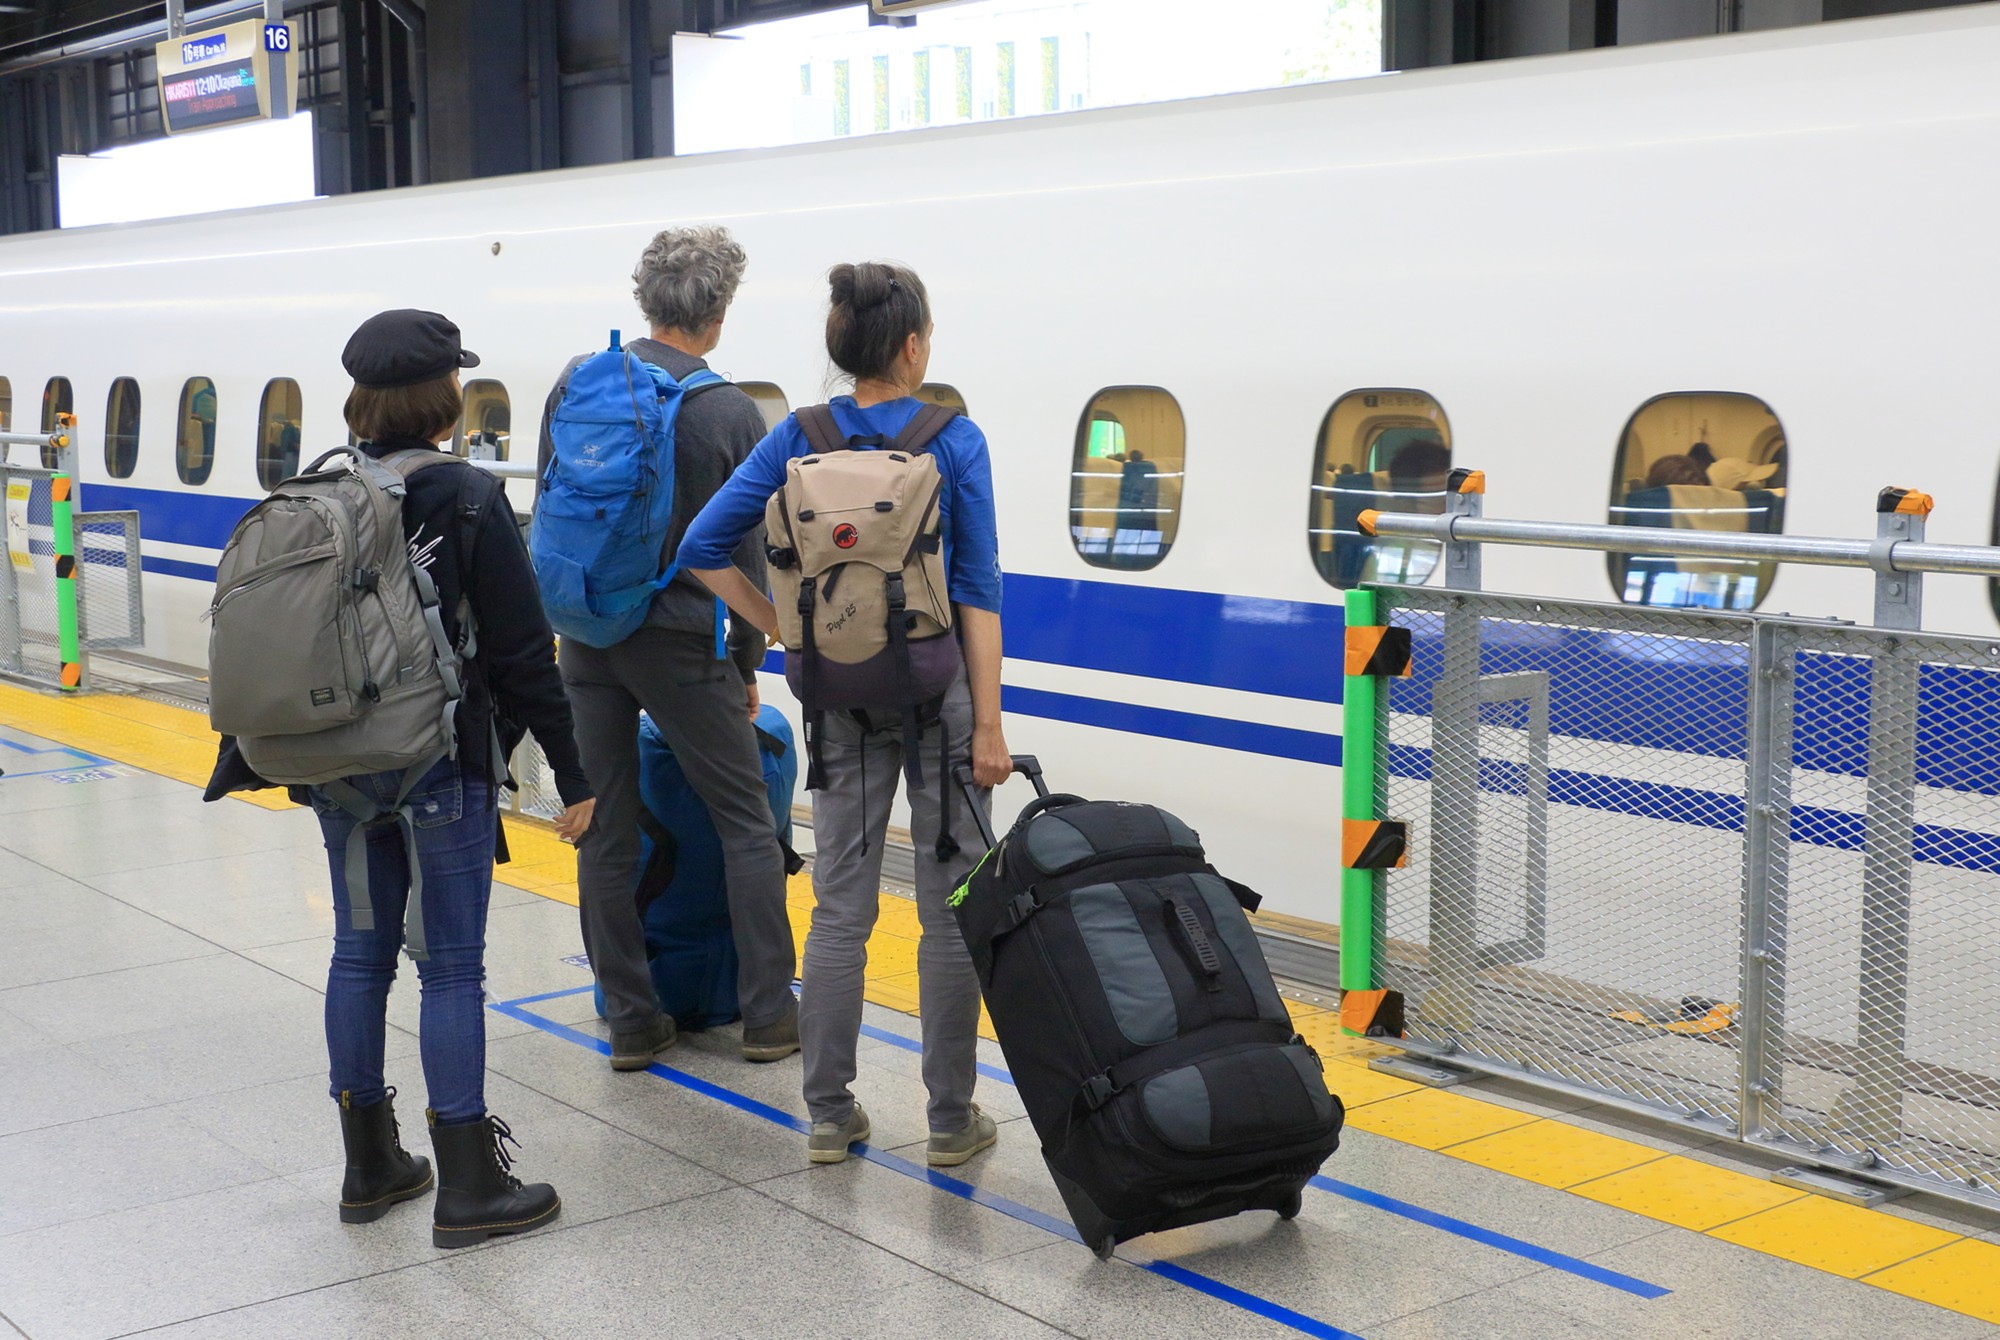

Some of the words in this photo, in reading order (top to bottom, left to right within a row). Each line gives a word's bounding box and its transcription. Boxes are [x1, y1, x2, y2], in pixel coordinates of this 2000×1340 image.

[265, 27, 288, 50] 16
[826, 614, 847, 634] Pizol
[845, 603, 857, 617] 25
